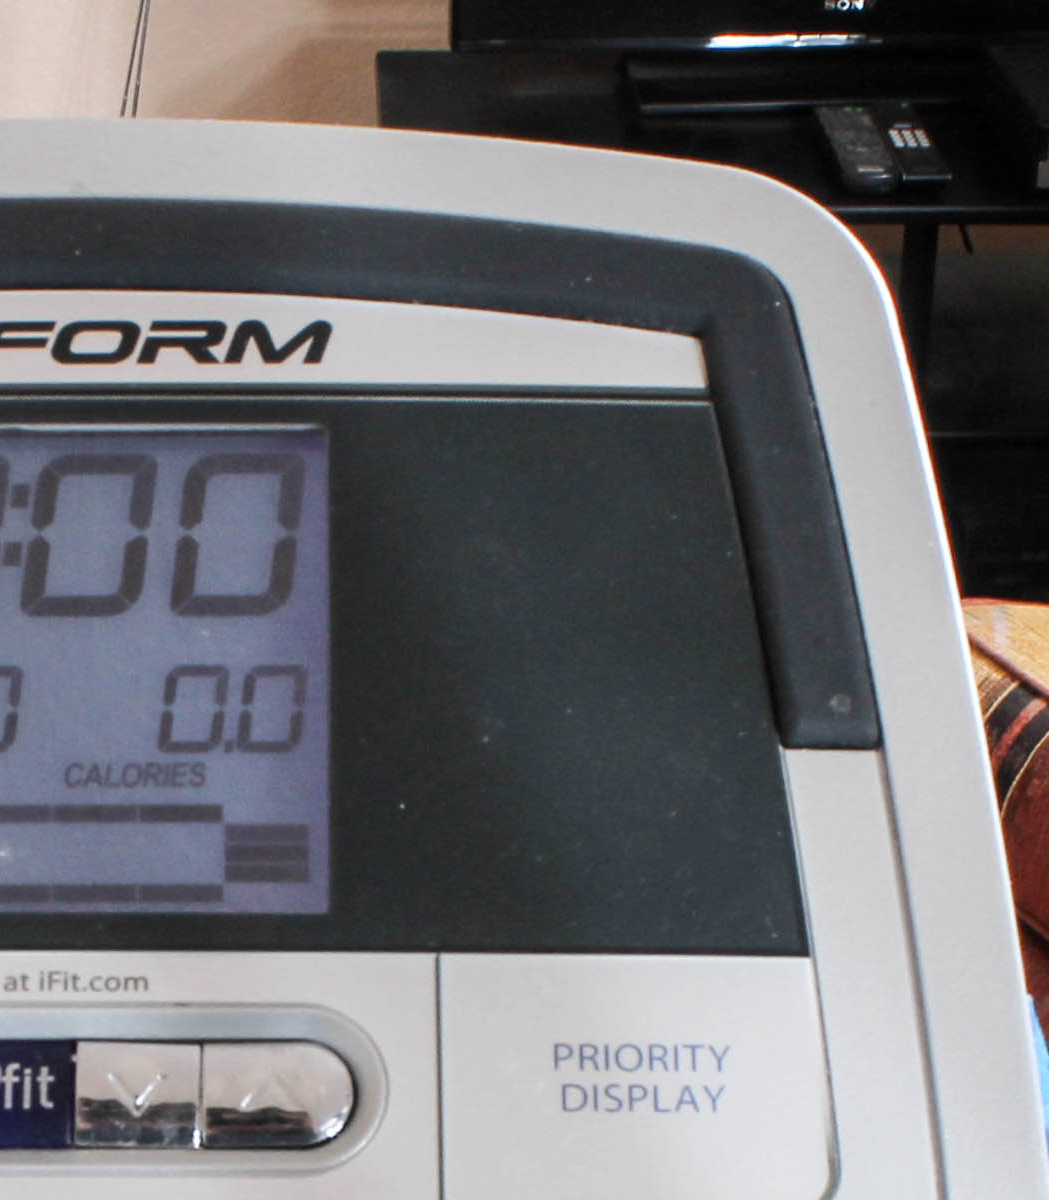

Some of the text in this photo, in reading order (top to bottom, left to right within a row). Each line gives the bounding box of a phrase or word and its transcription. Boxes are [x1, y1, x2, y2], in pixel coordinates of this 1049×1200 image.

[158, 664, 308, 753] 0.0
[64, 762, 206, 788] CALORIES
[3, 973, 30, 992] at
[38, 970, 149, 992] iFit.com
[553, 1043, 731, 1073] PRIORITY
[561, 1083, 726, 1113] DISPLAY
